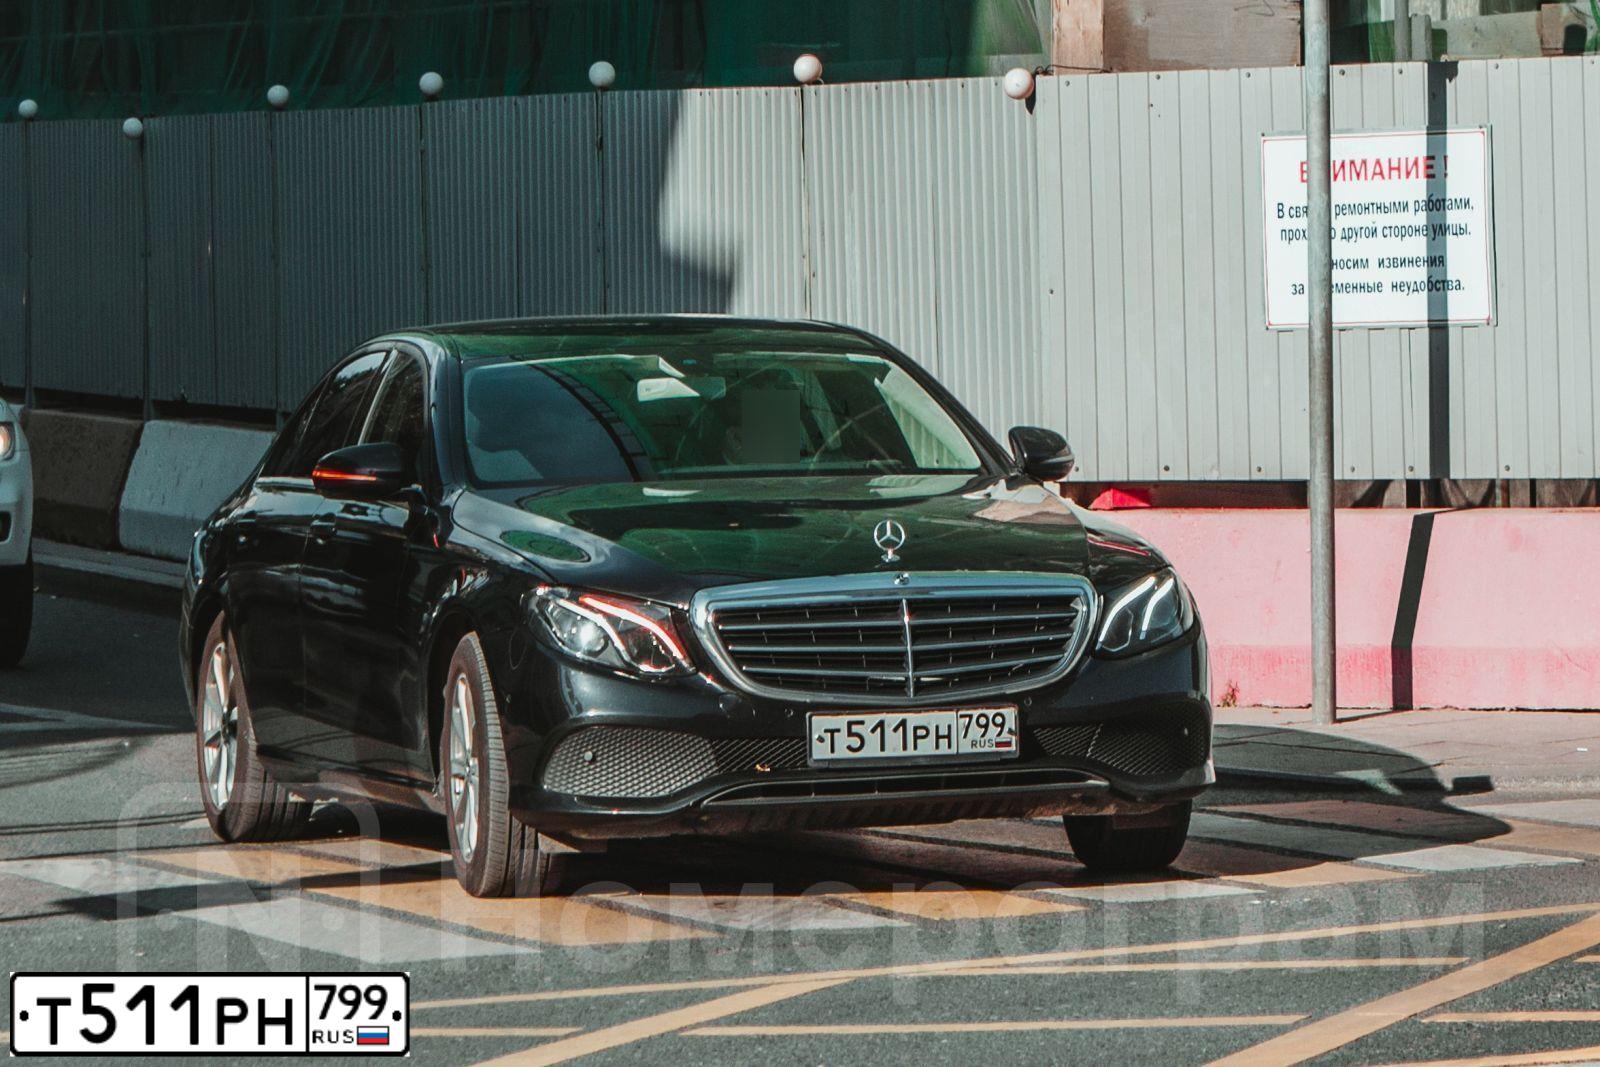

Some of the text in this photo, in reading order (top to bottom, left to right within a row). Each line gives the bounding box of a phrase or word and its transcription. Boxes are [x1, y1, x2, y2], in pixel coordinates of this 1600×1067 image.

[1299, 156, 1436, 182] ВИМАНИЕ
[1277, 202, 1285, 219] В
[1288, 205, 1308, 219] свя
[1334, 201, 1409, 219] ремонтными
[1340, 221, 1378, 243] другой
[1382, 224, 1429, 242] стороне
[1431, 222, 1472, 241] улицы.
[1377, 253, 1445, 270] извинения
[1291, 283, 1305, 296] за
[1391, 276, 1465, 297] неудобства.
[958, 711, 1006, 739] 799
[970, 738, 994, 749] RUS
